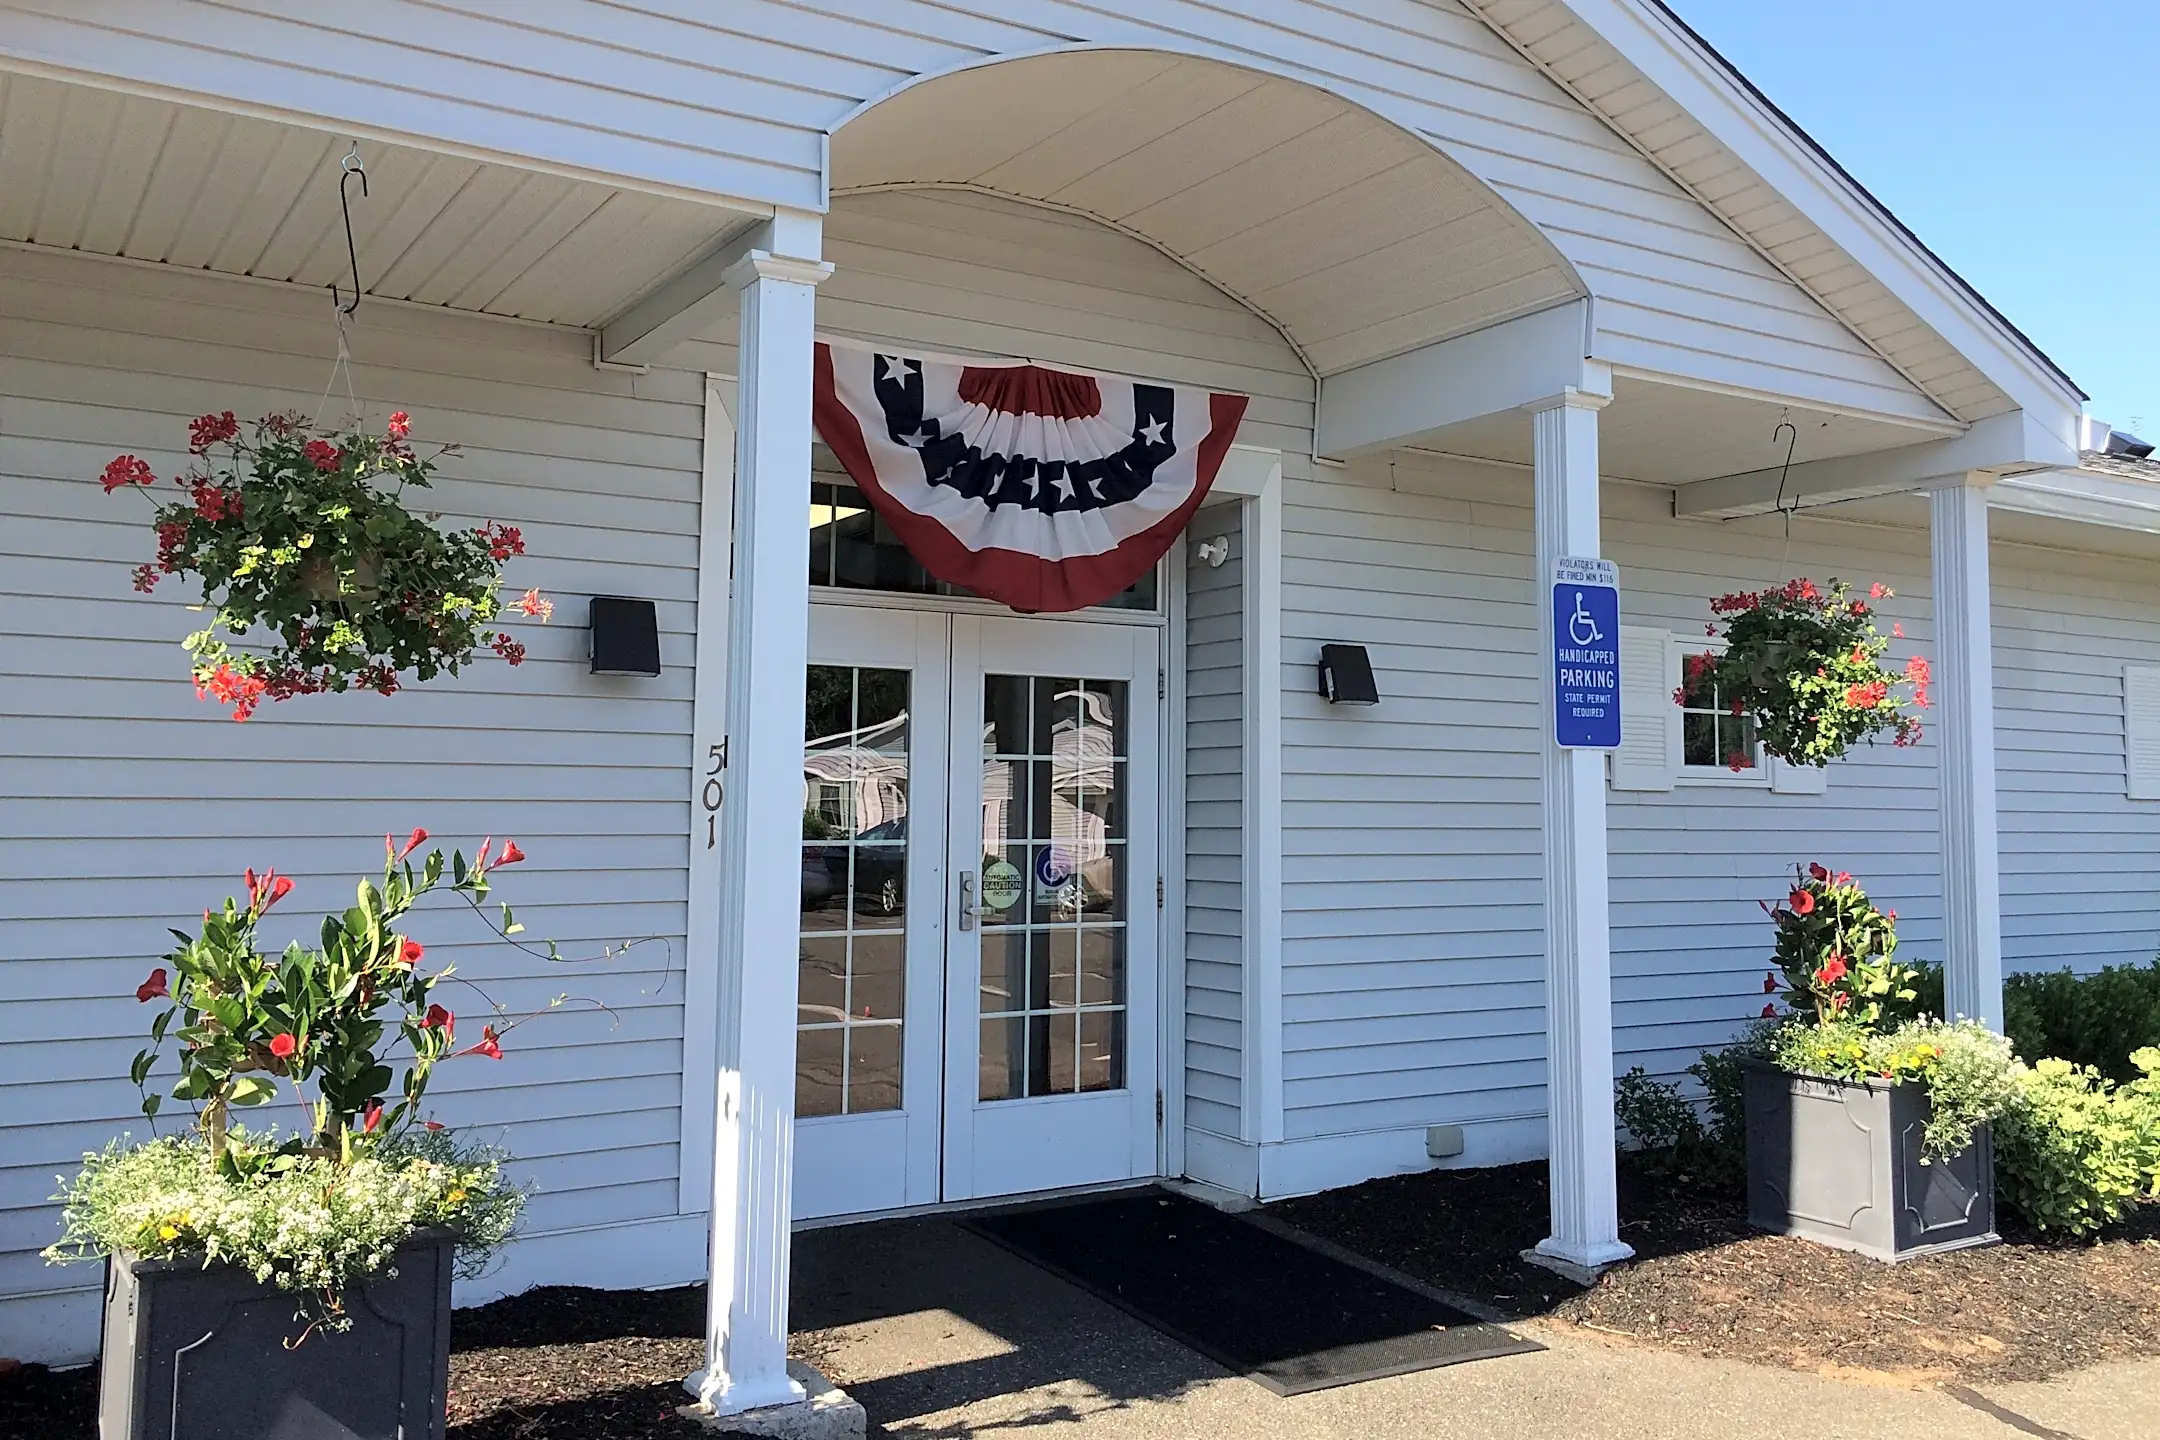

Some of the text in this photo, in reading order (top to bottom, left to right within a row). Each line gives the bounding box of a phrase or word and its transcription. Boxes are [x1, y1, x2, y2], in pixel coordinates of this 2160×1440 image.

[1558, 559, 1611, 571] VIOLATORS WILL
[1556, 570, 1565, 579] BE
[1567, 571, 1584, 580] FINED
[1559, 648, 1615, 665] HANDICAPPED
[1560, 668, 1614, 689] PARKING
[1564, 693, 1611, 704] STATE PERMIT
[1572, 707, 1605, 718] REQUIRED
[702, 744, 725, 849] 501
[983, 881, 1022, 890] CAUTION
